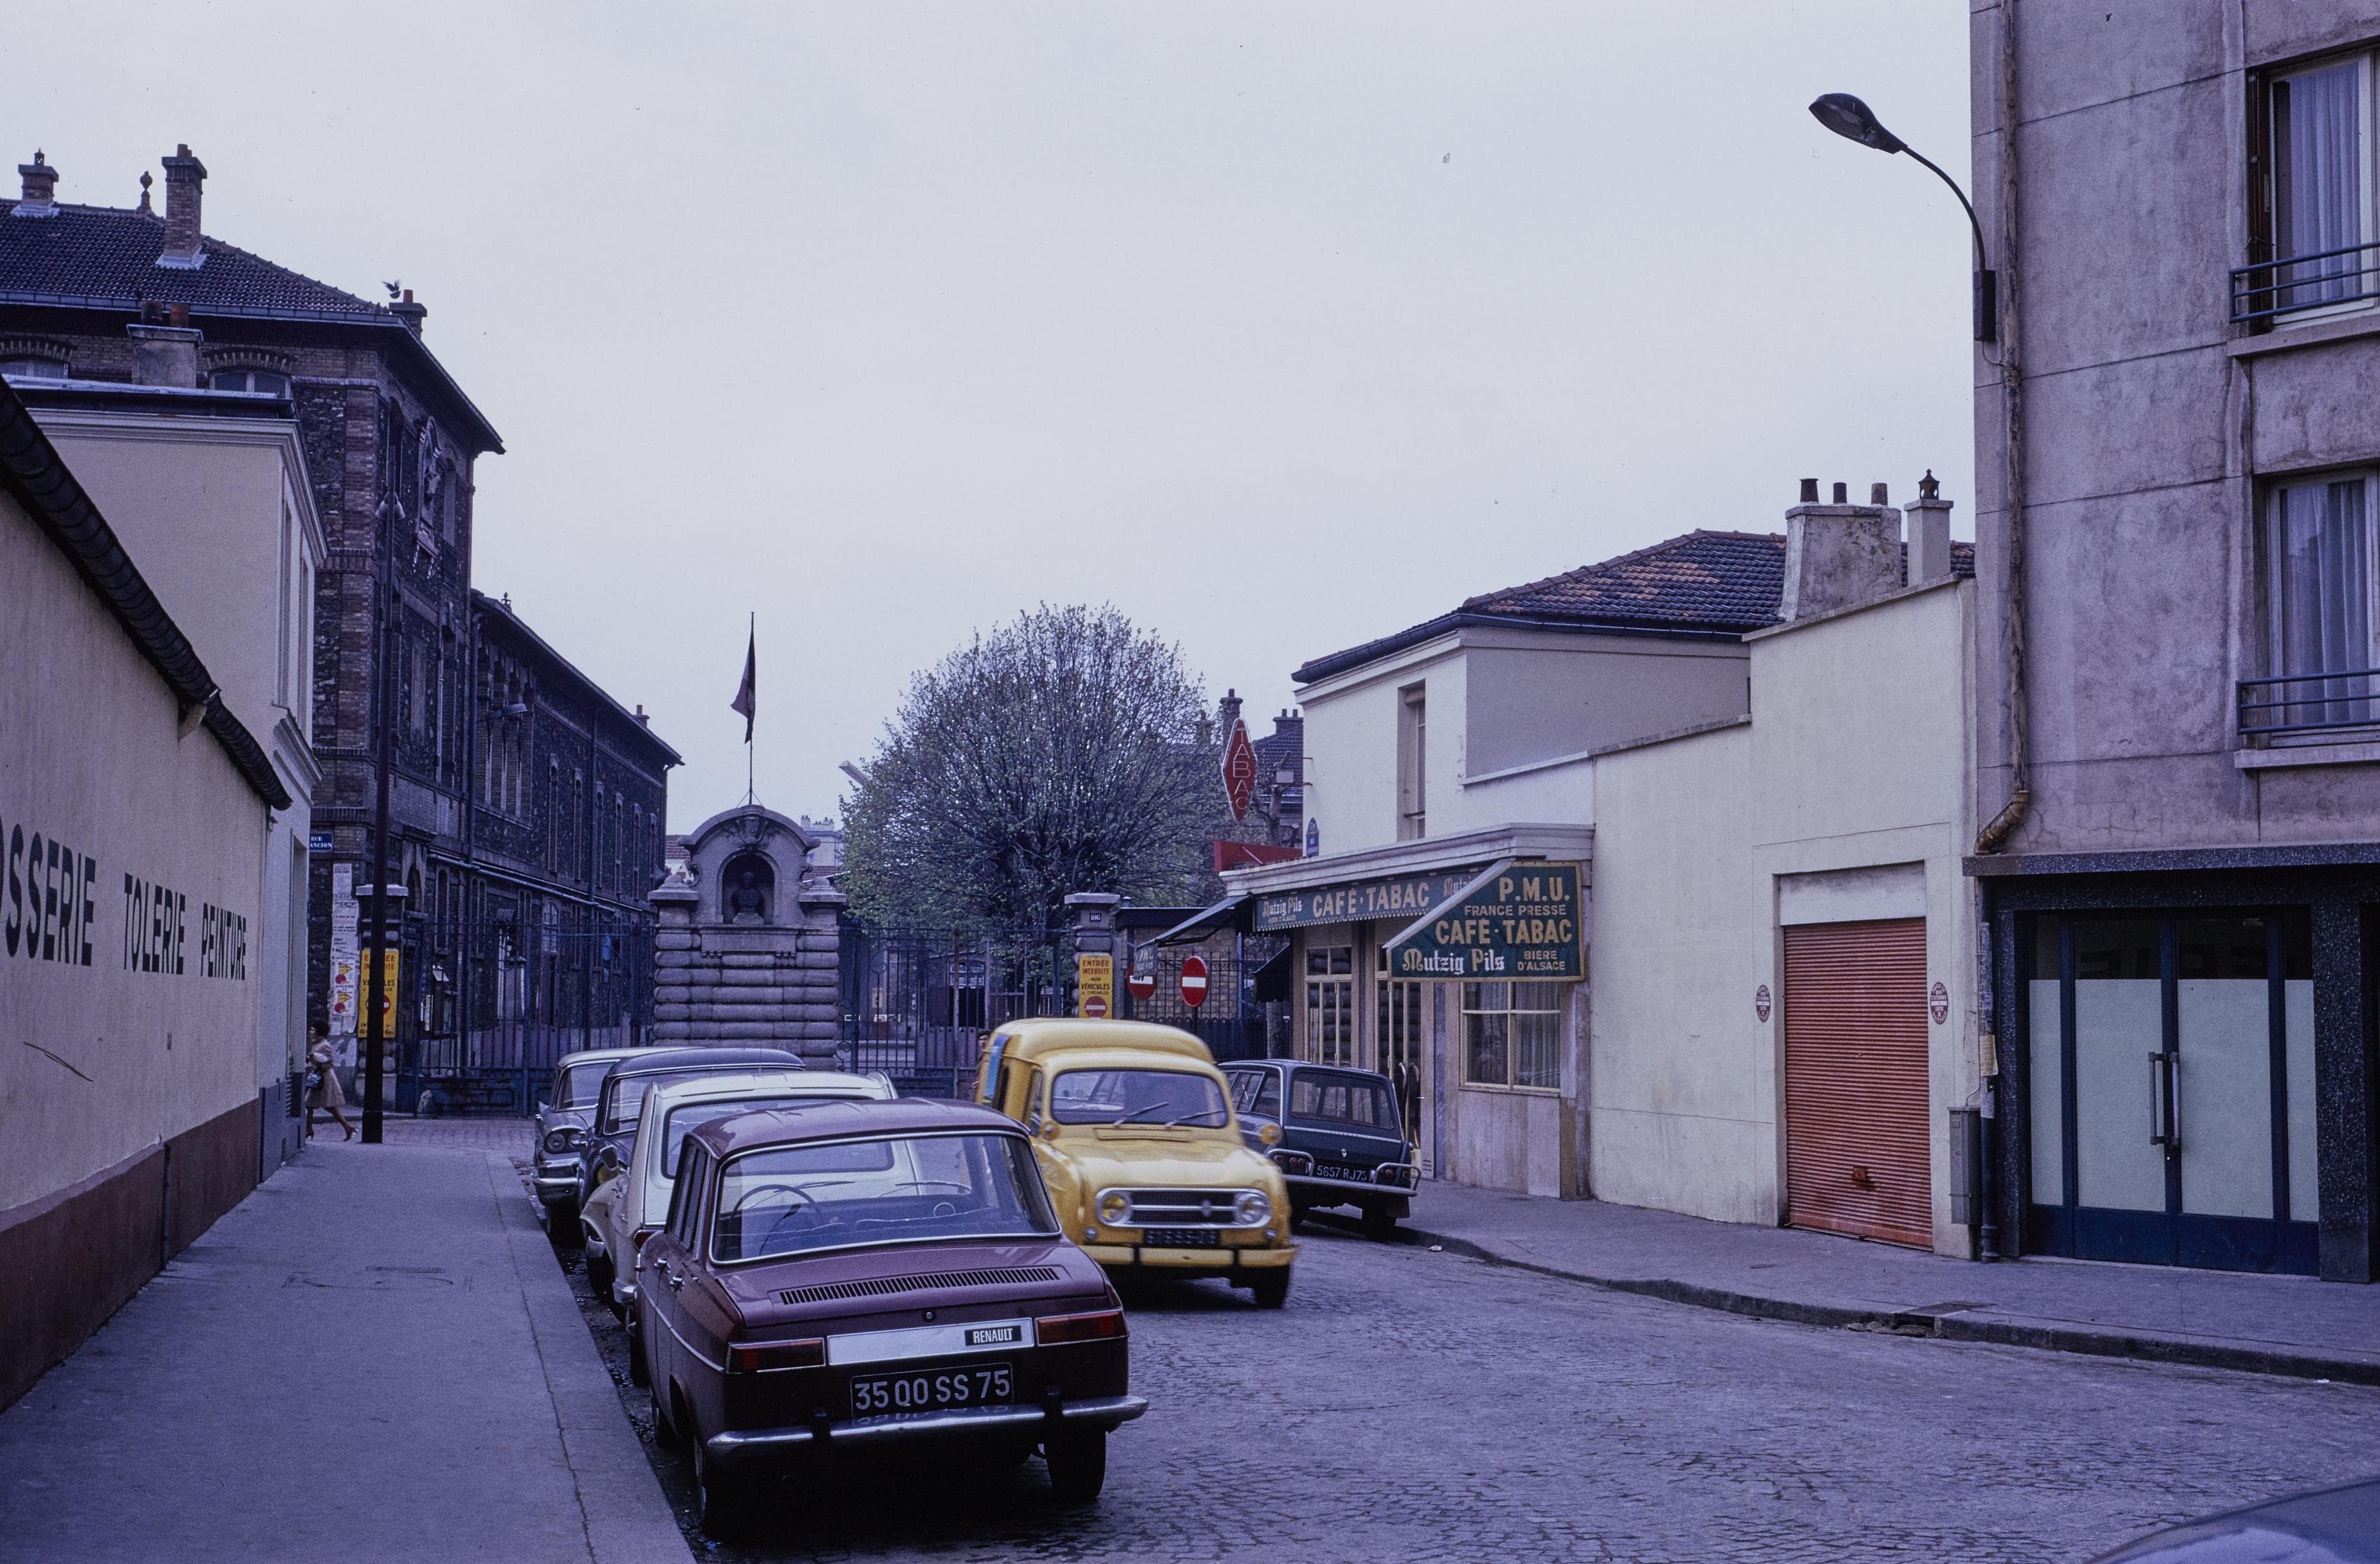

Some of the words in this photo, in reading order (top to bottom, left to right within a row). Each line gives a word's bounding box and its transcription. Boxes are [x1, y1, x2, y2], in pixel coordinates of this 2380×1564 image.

[1233, 727, 1251, 809] TABAC
[0, 813, 96, 966] SSERIE
[124, 872, 185, 975] TOLERIE
[200, 902, 246, 981] PEINTURE
[1263, 899, 1286, 917] Mutzig
[1288, 896, 1302, 914] Pils
[1312, 888, 1357, 917] CAFÉ
[1366, 882, 1429, 912] TABAC
[1499, 877, 1570, 902] P.M.U.
[1464, 905, 1513, 916] FRANCE
[1518, 905, 1566, 915] PRESSE
[1436, 918, 1491, 944] CAFÉ
[1503, 919, 1572, 944] TABAC
[1402, 948, 1464, 975] Mutzig
[1471, 948, 1505, 971] Pils
[1517, 961, 1566, 971] D'ALSACE
[1317, 1165, 1341, 1178] 5657
[973, 1328, 1013, 1344] RENAULT
[935, 1374, 969, 1403] SS
[976, 1370, 1011, 1399] 75
